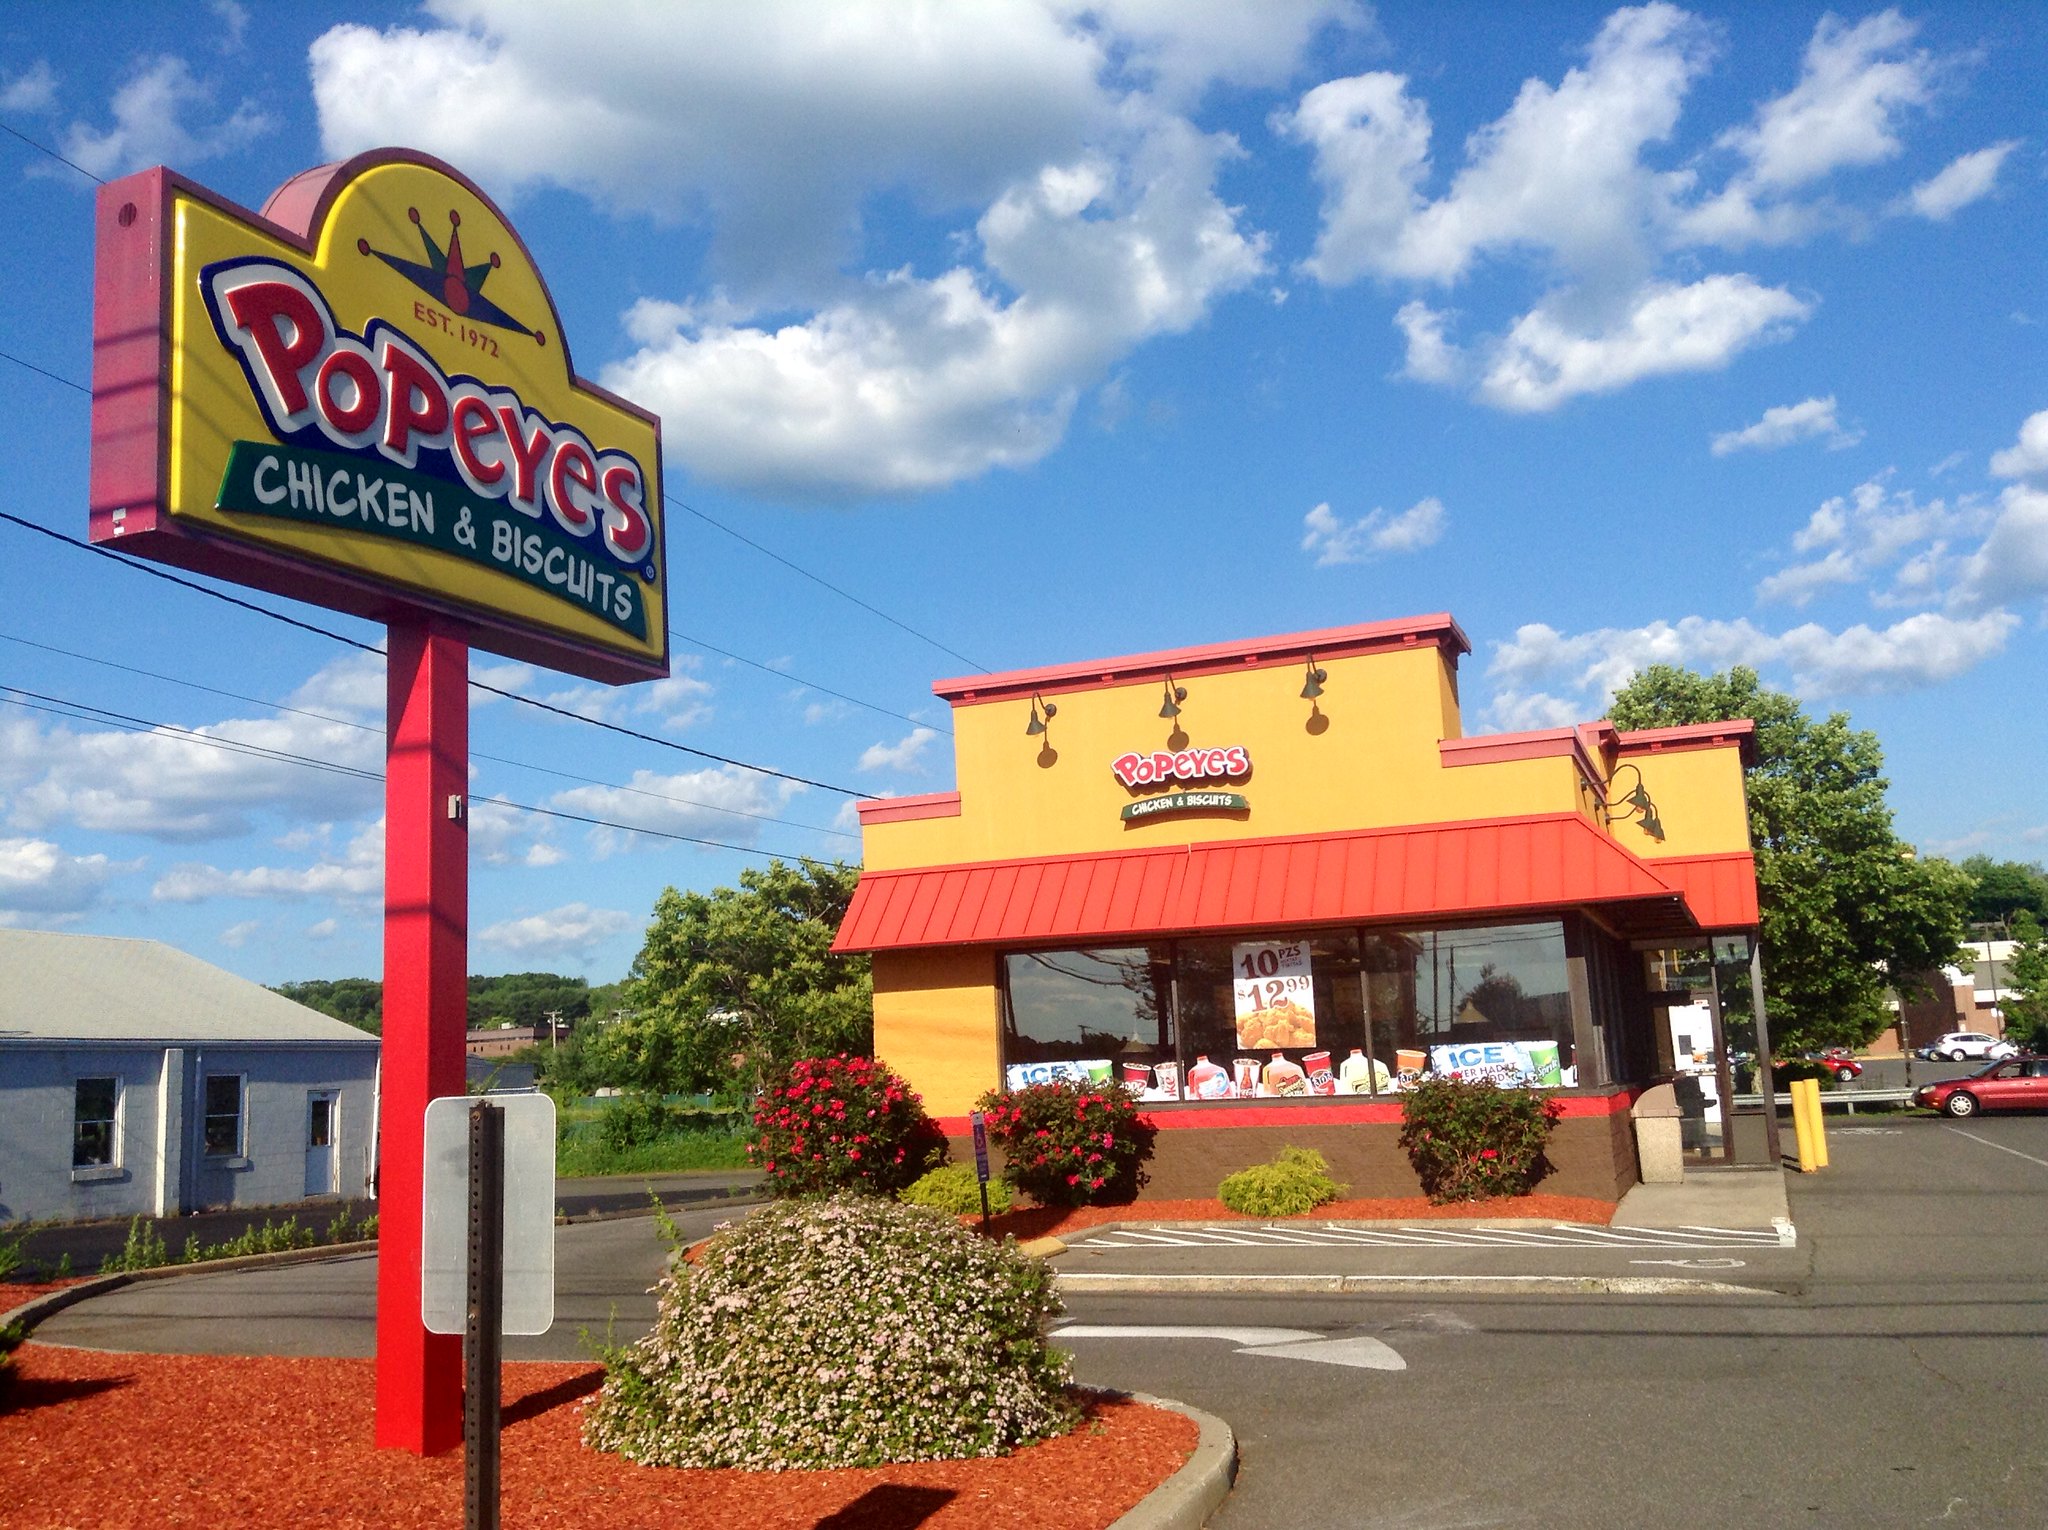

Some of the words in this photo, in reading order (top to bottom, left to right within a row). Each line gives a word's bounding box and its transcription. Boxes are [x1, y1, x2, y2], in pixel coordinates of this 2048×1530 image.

[414, 301, 454, 336] EST.
[460, 324, 499, 358] 1972
[253, 455, 435, 534] CHICKEN
[453, 505, 477, 549] &
[491, 519, 633, 621] BISCUITS
[1131, 796, 1173, 815] CHICKEN
[1176, 796, 1184, 807] &
[1186, 794, 1232, 807] BISCUITS
[1241, 949, 1279, 980] 10
[1448, 1046, 1505, 1069] ICE
